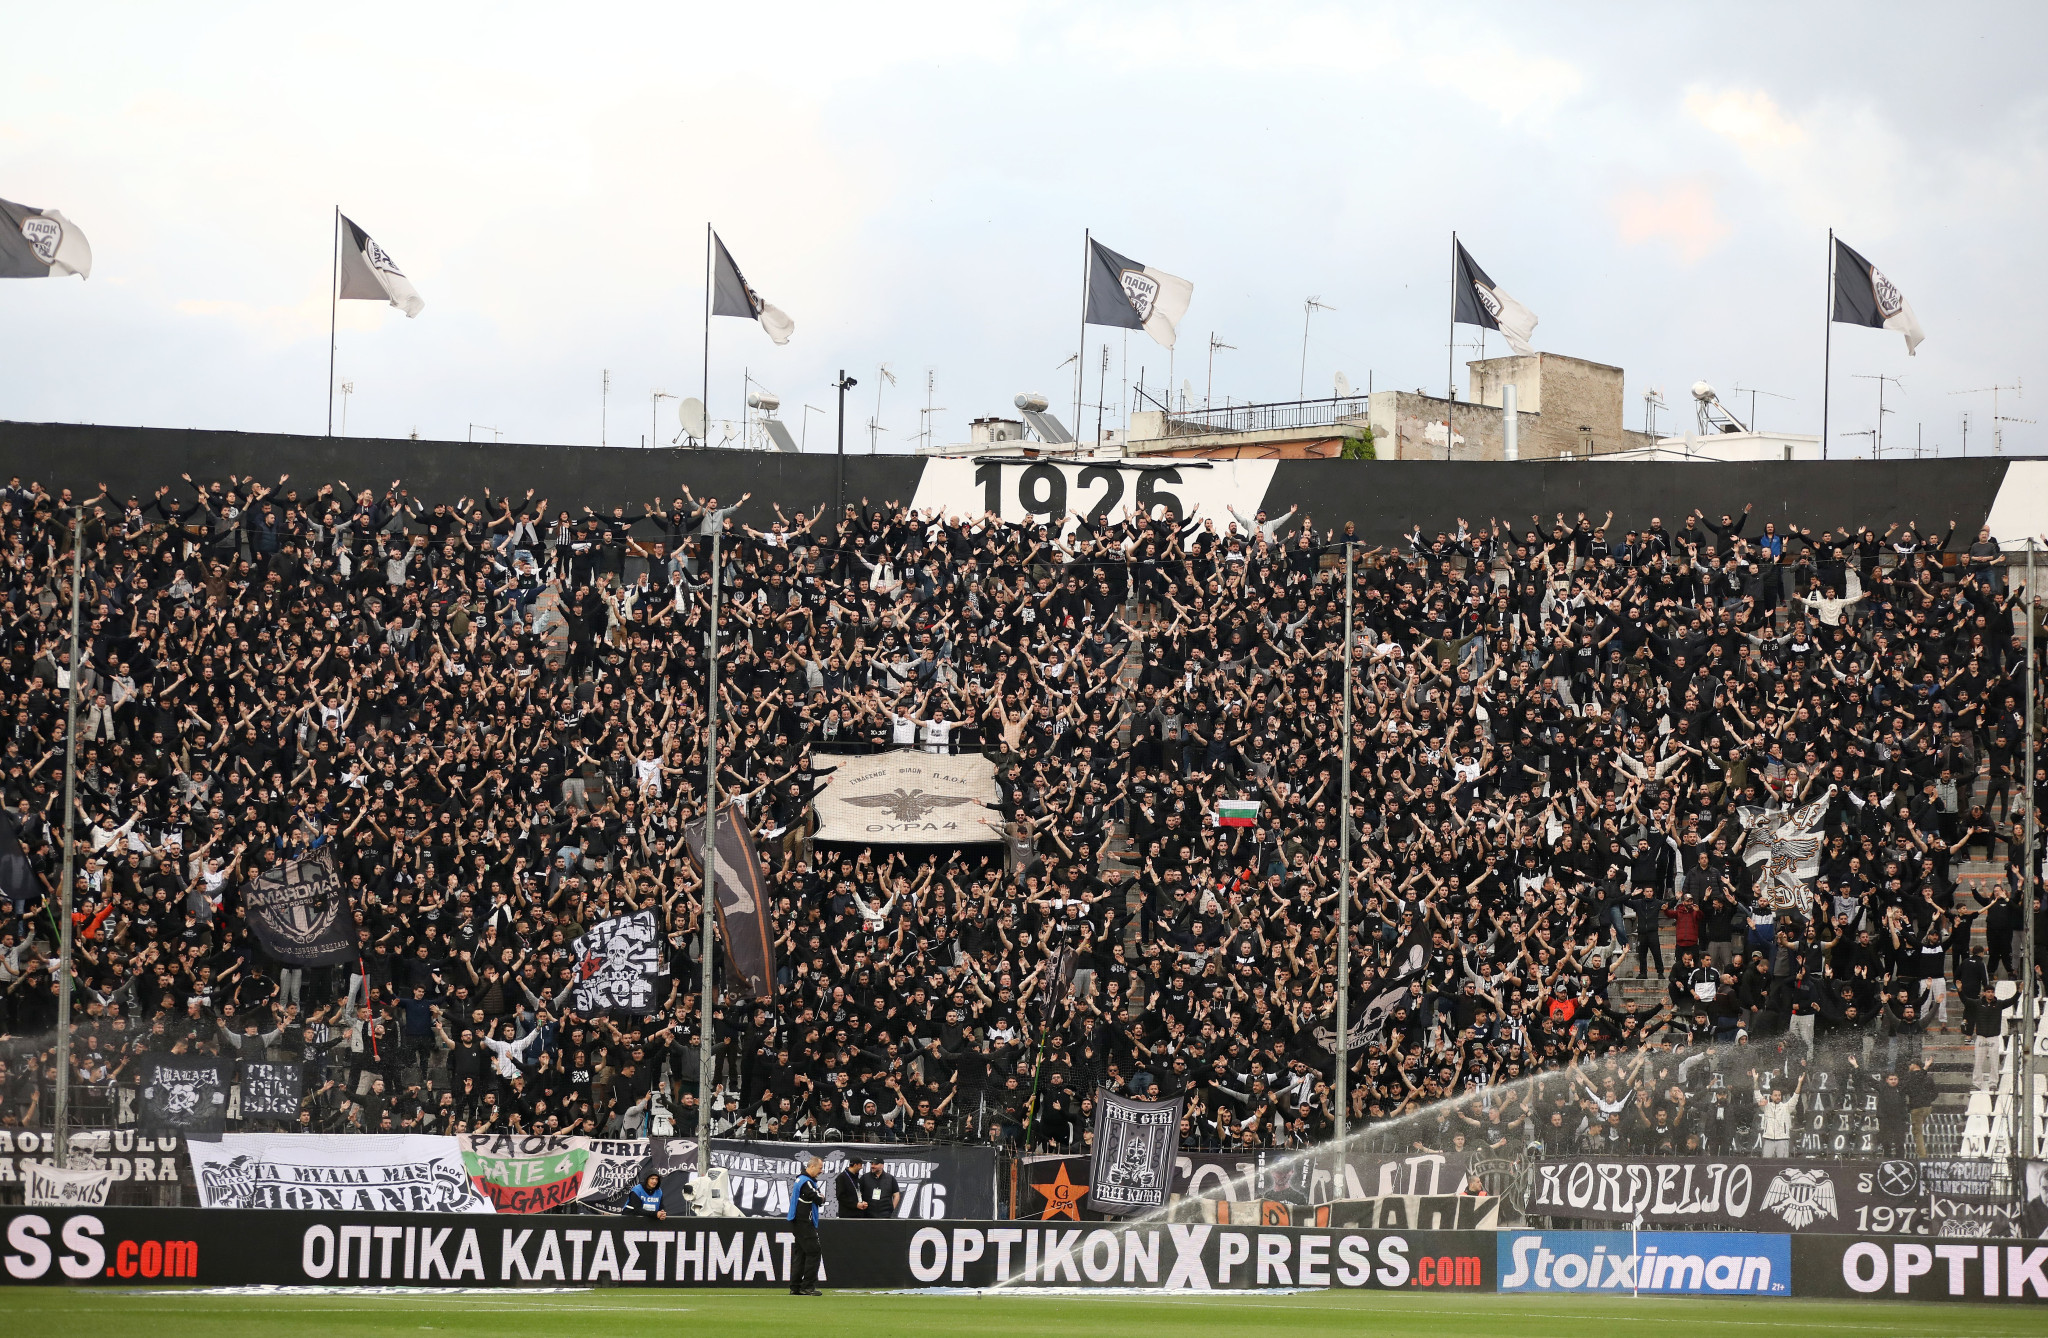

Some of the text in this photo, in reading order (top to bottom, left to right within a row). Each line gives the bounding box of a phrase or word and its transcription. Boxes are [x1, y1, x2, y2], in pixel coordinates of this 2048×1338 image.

[974, 463, 1184, 545] 1926
[866, 821, 958, 832] ΘΥΡΑ 4
[1106, 1104, 1138, 1123] FREE
[554, 1153, 575, 1175] 4
[1096, 1183, 1125, 1200] FREE
[303, 1224, 486, 1280] ΟΠΤΙΚΑ
[1502, 1236, 1772, 1292] Stoiximan
